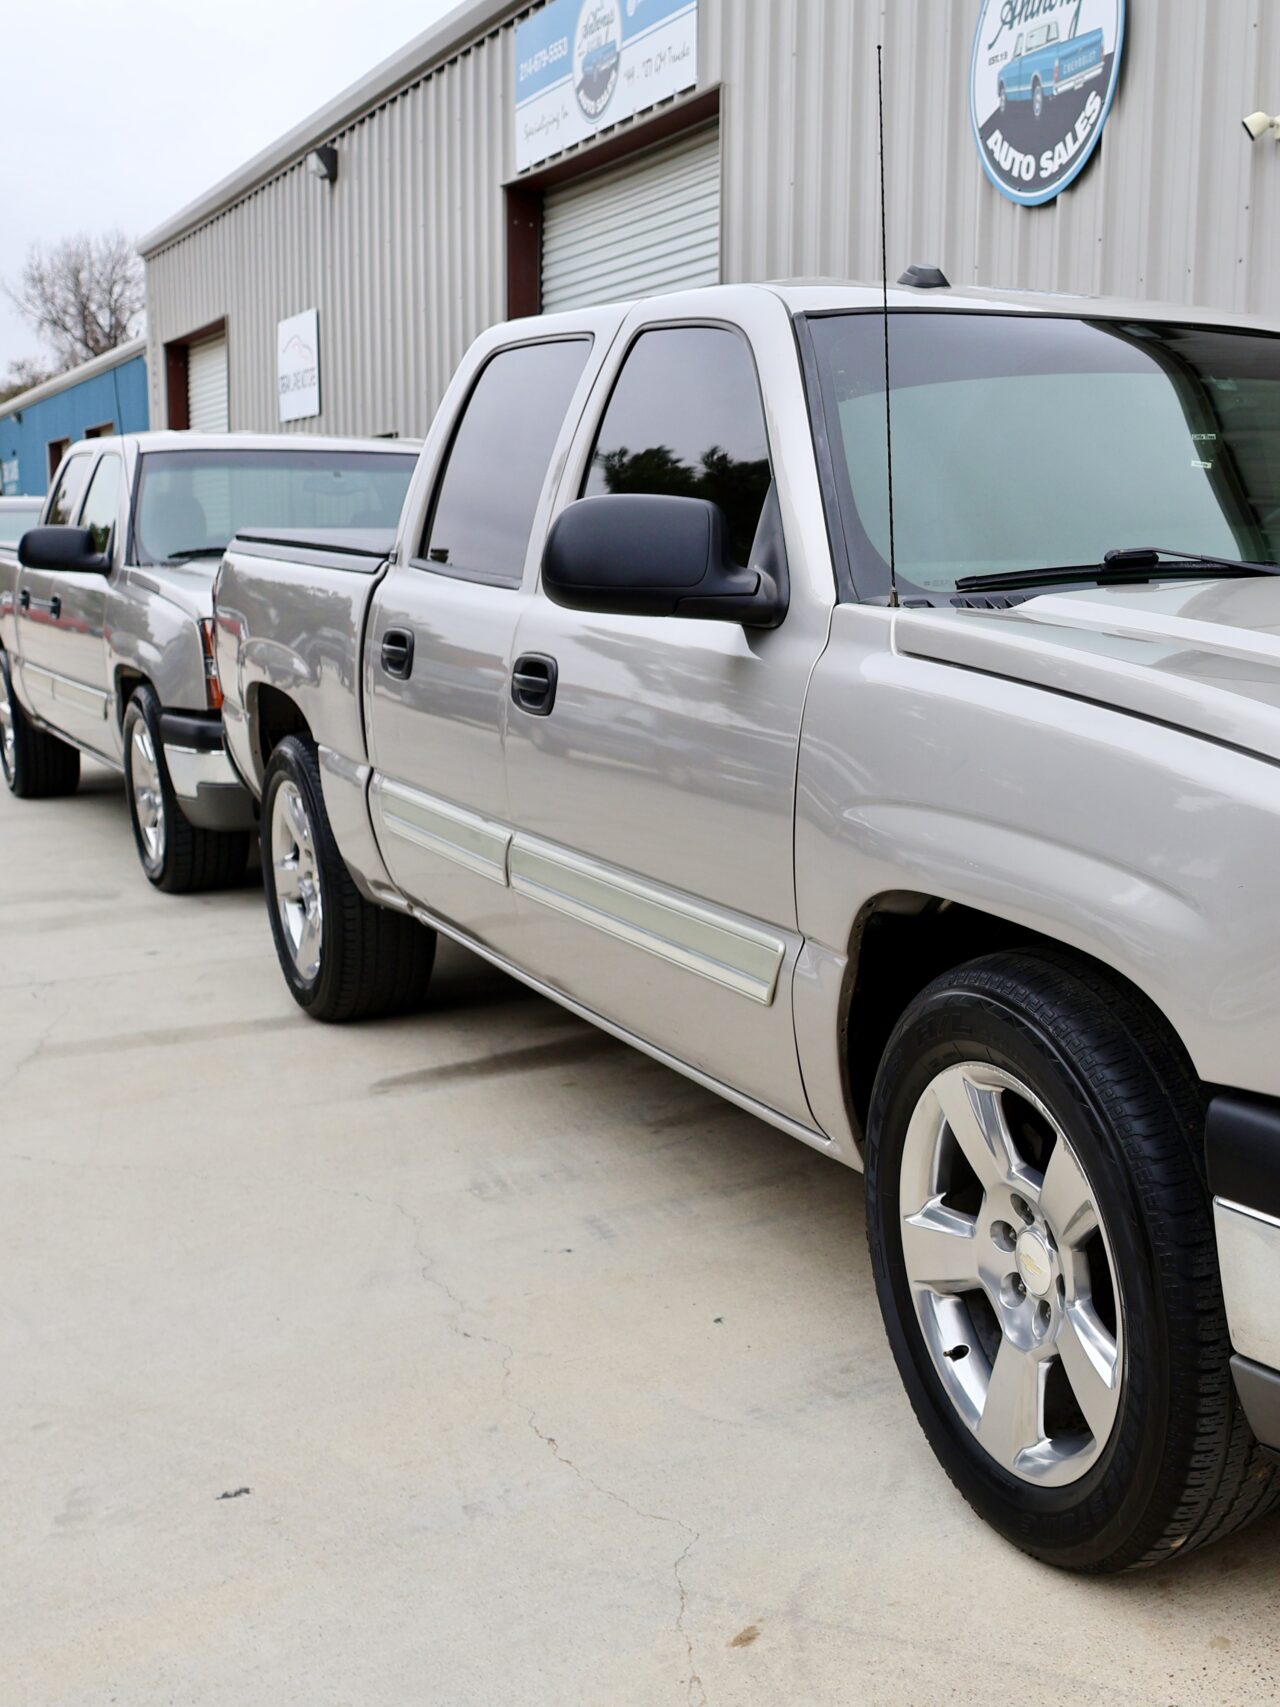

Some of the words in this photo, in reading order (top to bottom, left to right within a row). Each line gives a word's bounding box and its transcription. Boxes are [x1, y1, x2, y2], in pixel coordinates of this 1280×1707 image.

[1063, 50, 1097, 75] CHEVROLET
[986, 129, 1036, 182] AUTO
[1039, 90, 1102, 179] SALES
